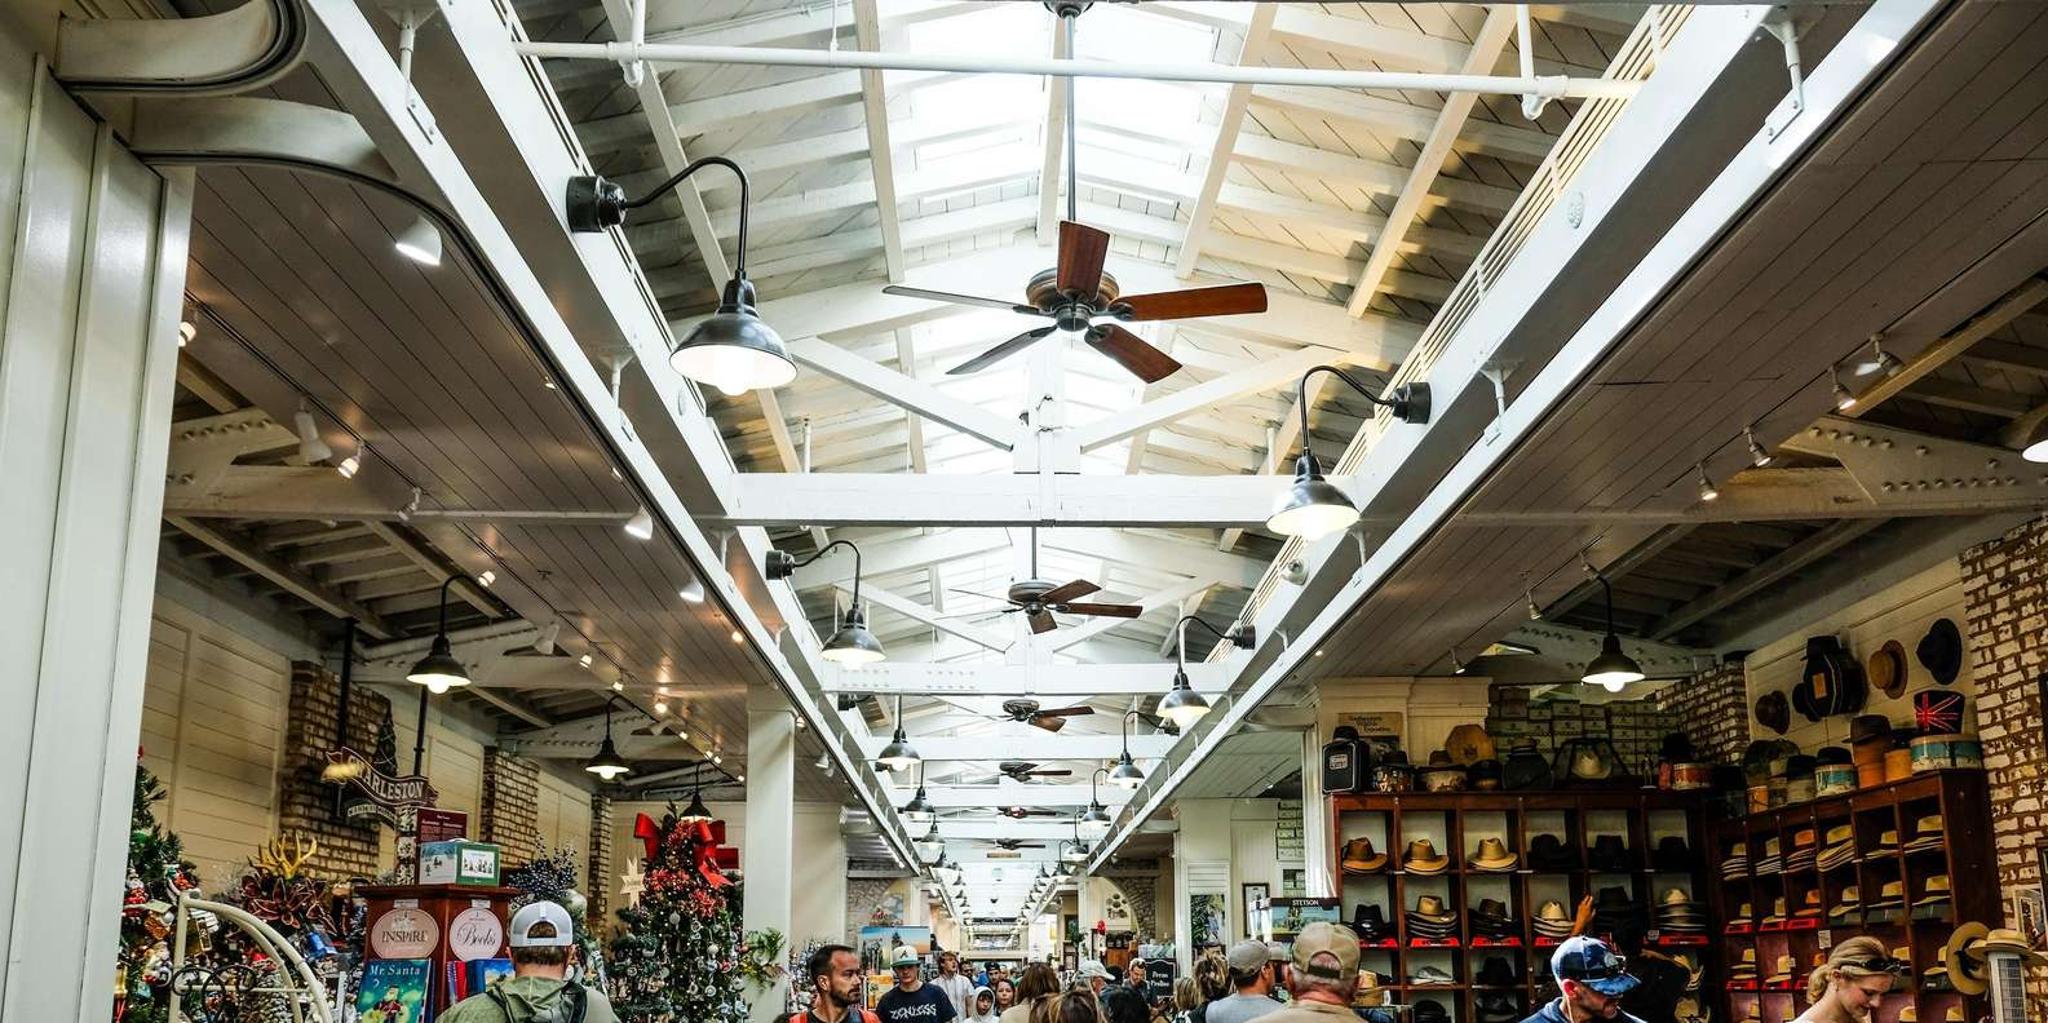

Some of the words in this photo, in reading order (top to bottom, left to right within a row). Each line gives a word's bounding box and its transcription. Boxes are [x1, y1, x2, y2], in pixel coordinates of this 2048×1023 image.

[382, 929, 427, 943] INSPIRE
[456, 922, 497, 946] Books
[387, 964, 421, 975] Santa
